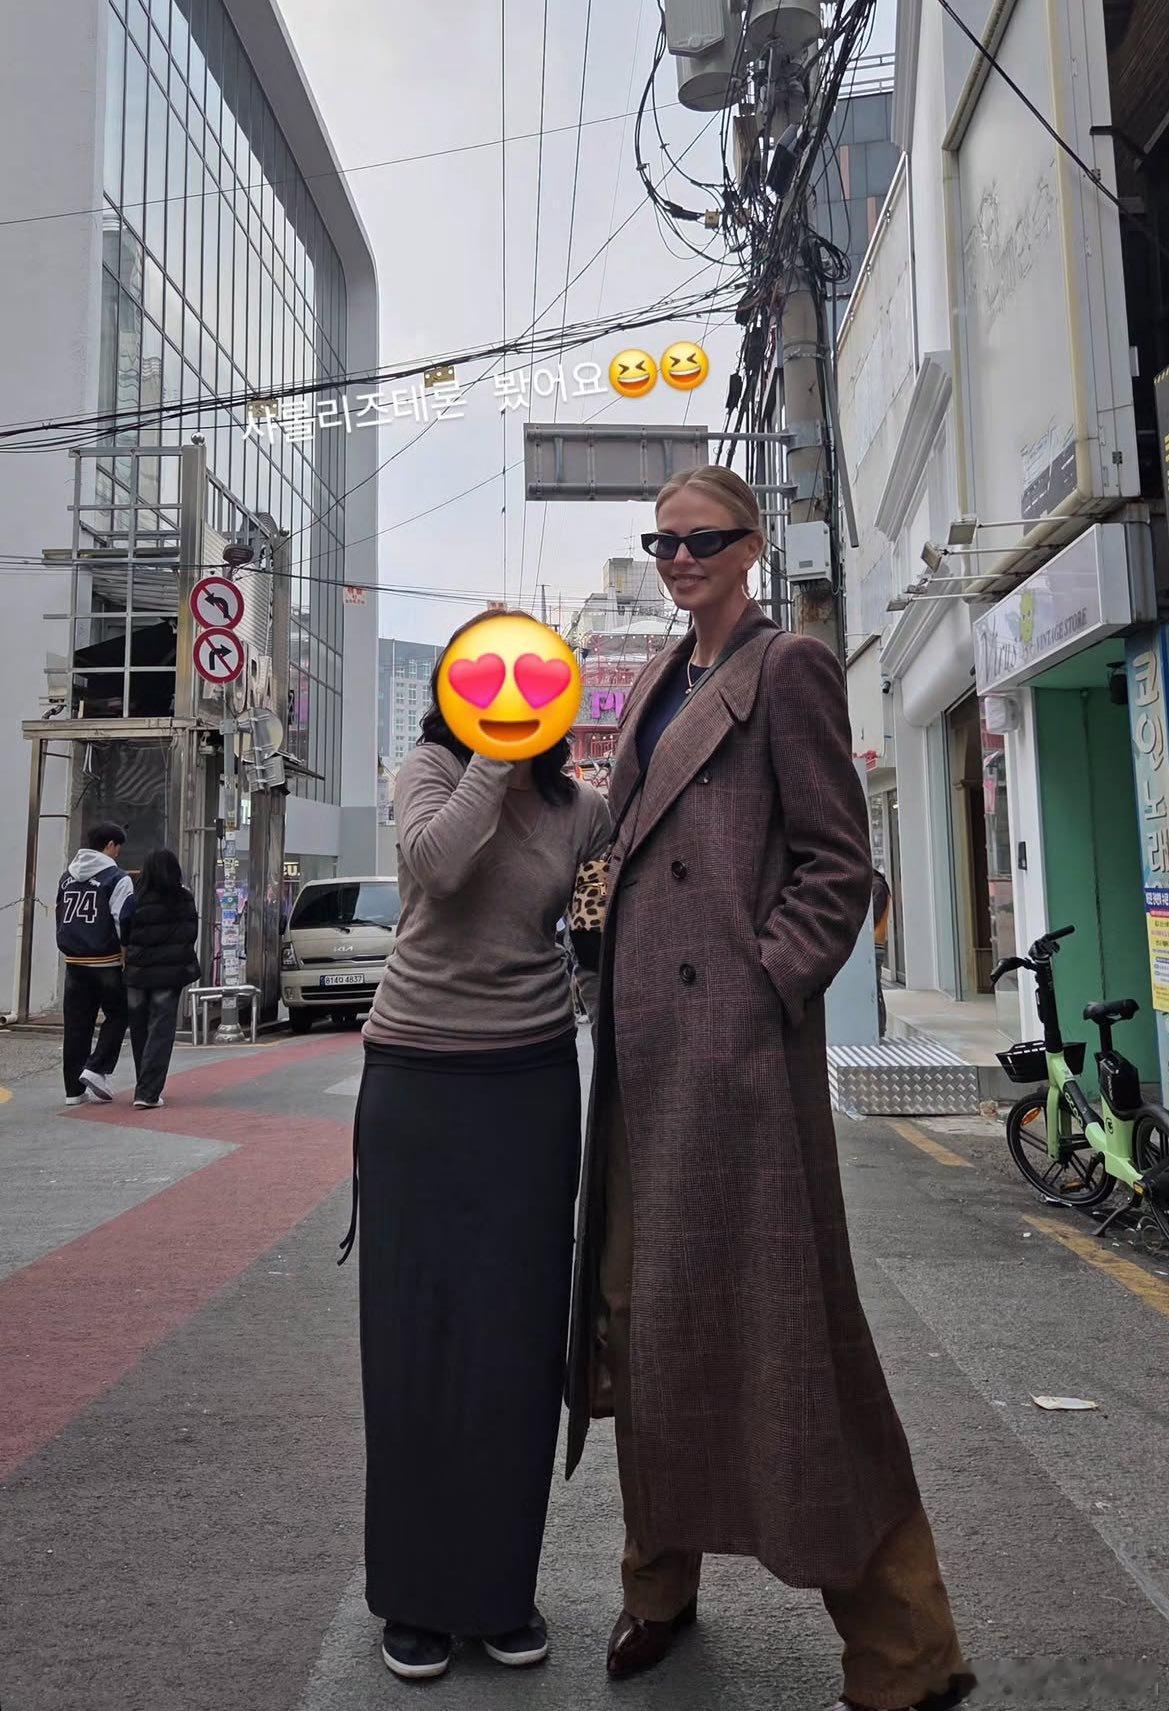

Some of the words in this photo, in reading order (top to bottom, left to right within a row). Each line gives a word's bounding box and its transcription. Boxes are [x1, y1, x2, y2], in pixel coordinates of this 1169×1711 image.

[1064, 608, 1088, 637] STORE
[1133, 651, 1169, 884] 코인노래
[63, 891, 98, 924] 74
